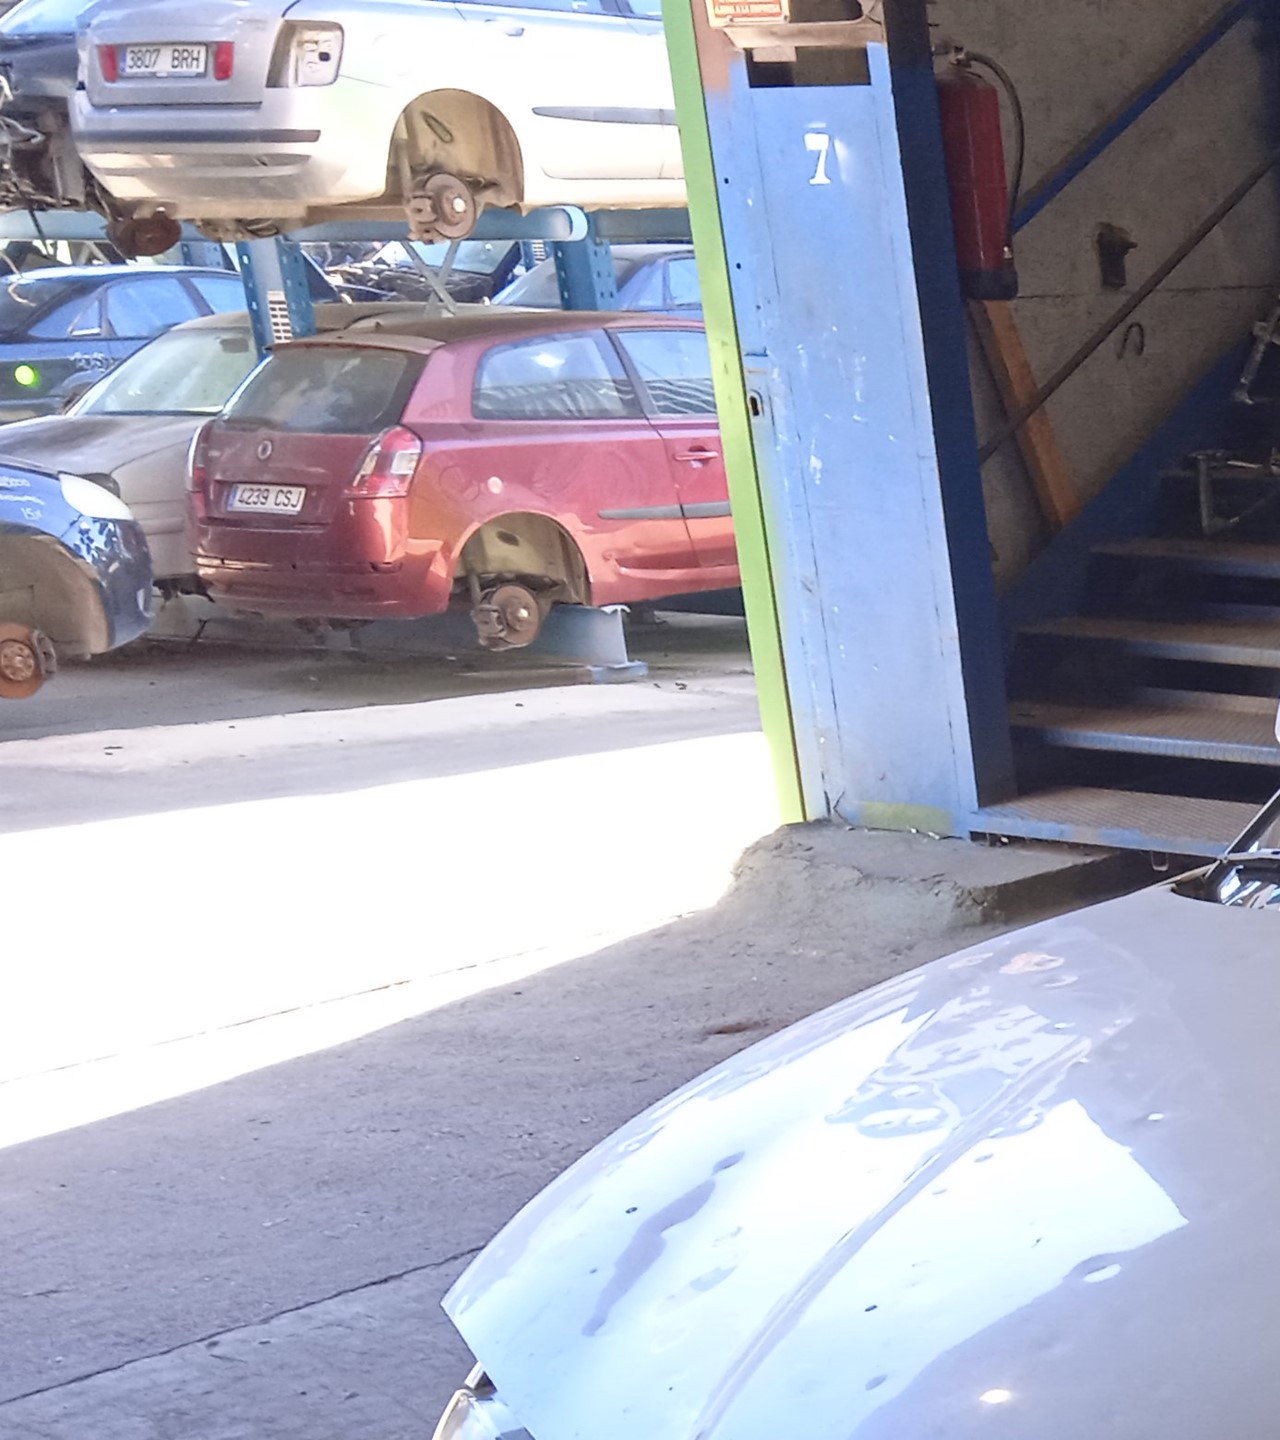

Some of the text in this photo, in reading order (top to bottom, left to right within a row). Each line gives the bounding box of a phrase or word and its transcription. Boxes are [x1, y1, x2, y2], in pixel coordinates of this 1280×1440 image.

[128, 48, 200, 69] 3807 BRH
[804, 132, 832, 185] 7
[238, 487, 302, 508] 4239 CSJ
